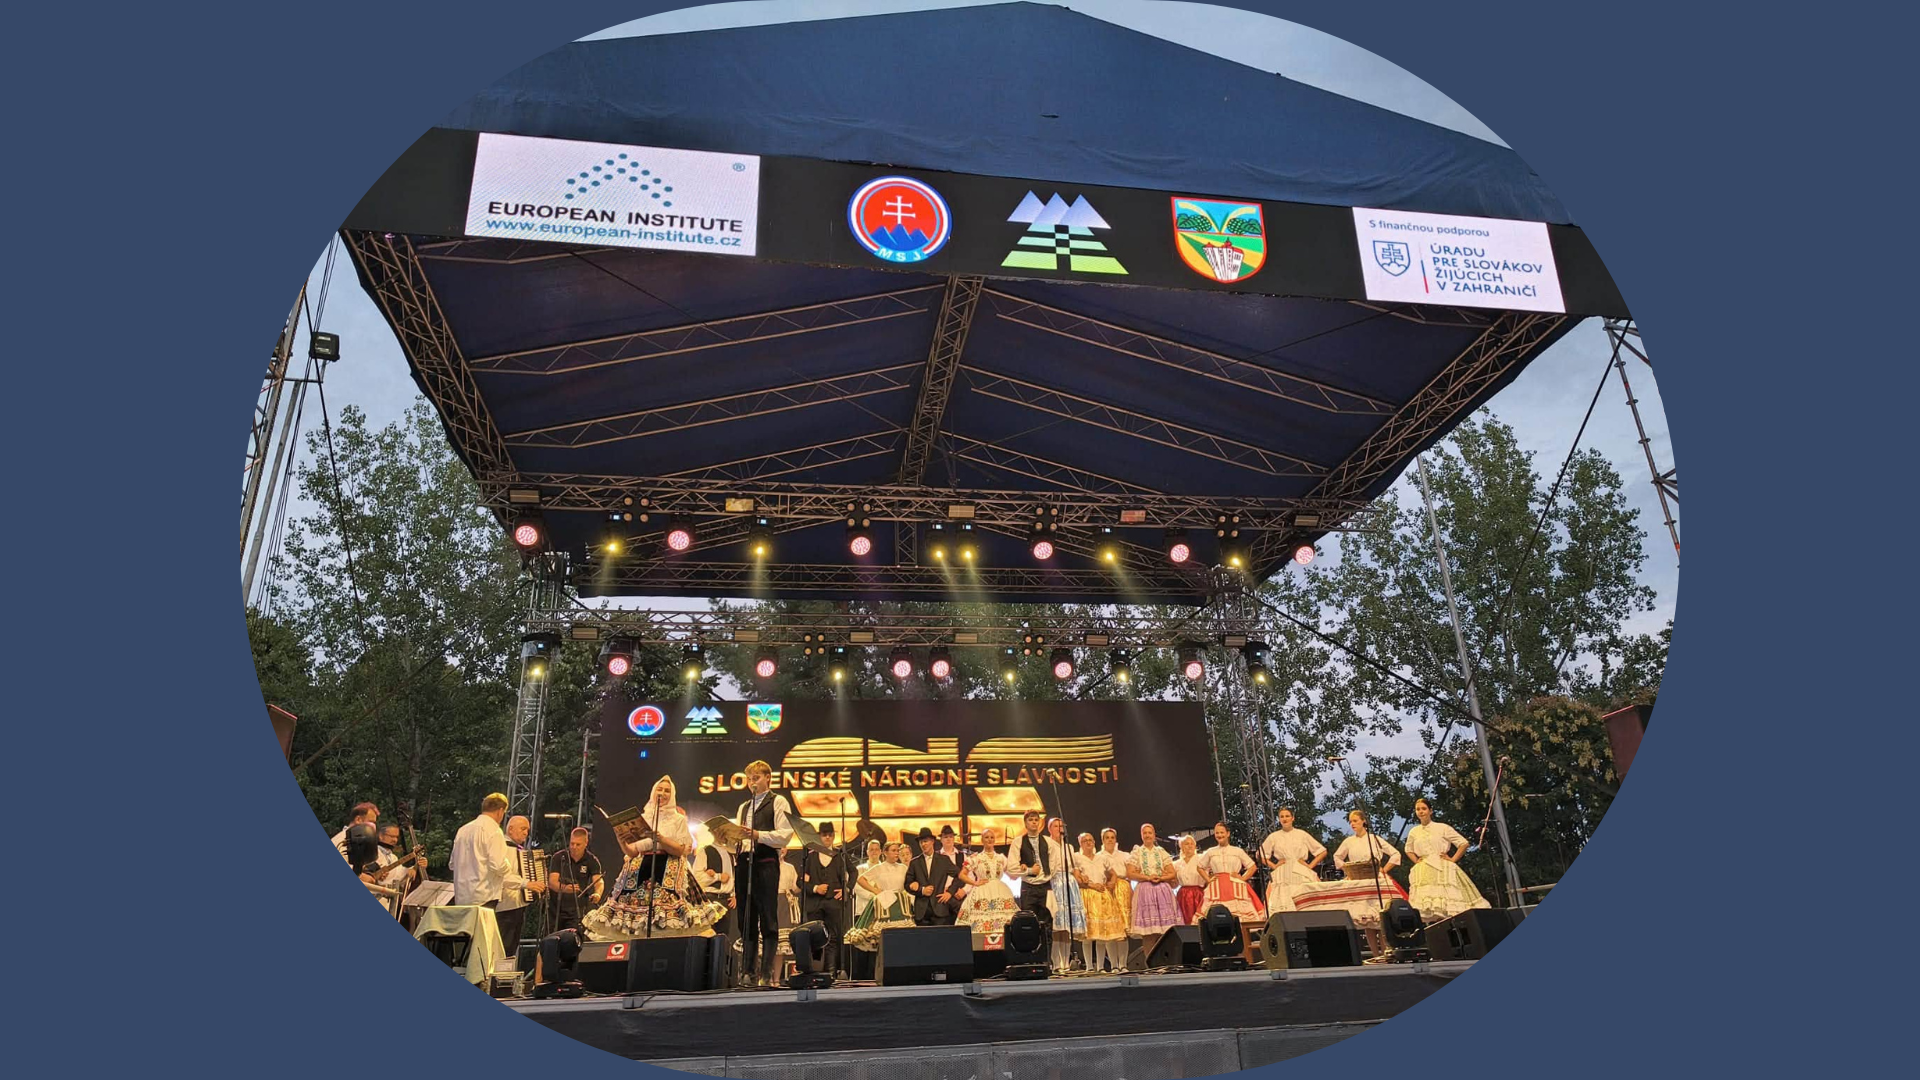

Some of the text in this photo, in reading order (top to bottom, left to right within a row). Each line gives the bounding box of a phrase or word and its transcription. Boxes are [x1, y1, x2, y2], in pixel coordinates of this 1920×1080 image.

[487, 201, 743, 232] EUROPEAN INSTITUTE
[486, 219, 742, 247] www.european-institute.cz
[1369, 219, 1490, 238] S finančnou podporou
[1430, 243, 1485, 257] ÚRADU
[1432, 257, 1542, 274] PRE SLOVÁKOV
[1435, 267, 1503, 282] ŽIJÚCICH
[1436, 280, 1537, 297] V ZAHRANIČÍ
[698, 767, 852, 794] SLOENSKÉ
[860, 765, 979, 788] NÁRODNÉ
